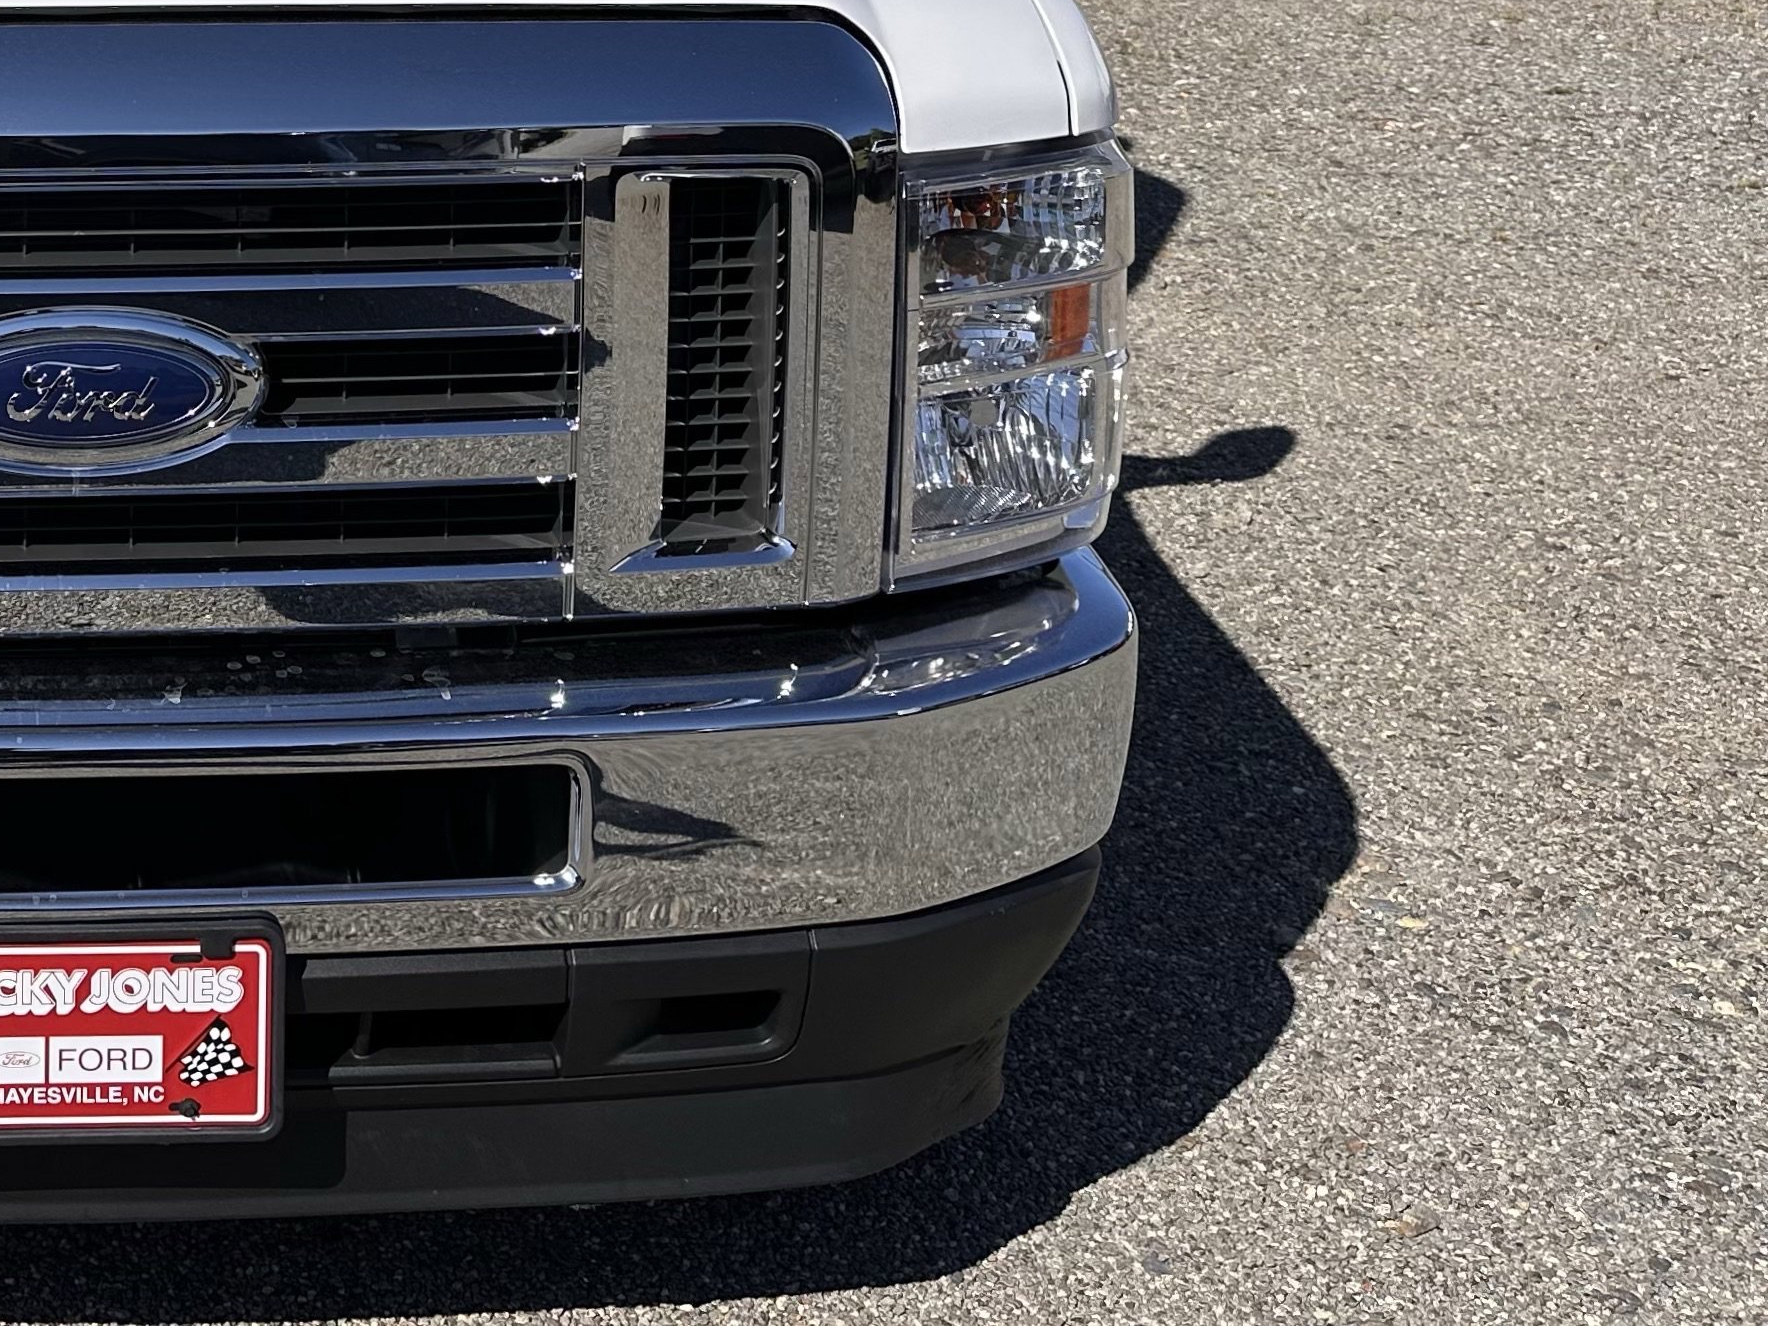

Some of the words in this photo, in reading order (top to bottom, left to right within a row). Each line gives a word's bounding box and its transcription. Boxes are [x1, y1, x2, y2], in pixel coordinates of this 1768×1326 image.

[6, 360, 160, 423] Ford
[81, 965, 245, 1015] JONES
[2, 1053, 33, 1066] Ford
[57, 1047, 153, 1072] FORD
[133, 1085, 165, 1103] NC
